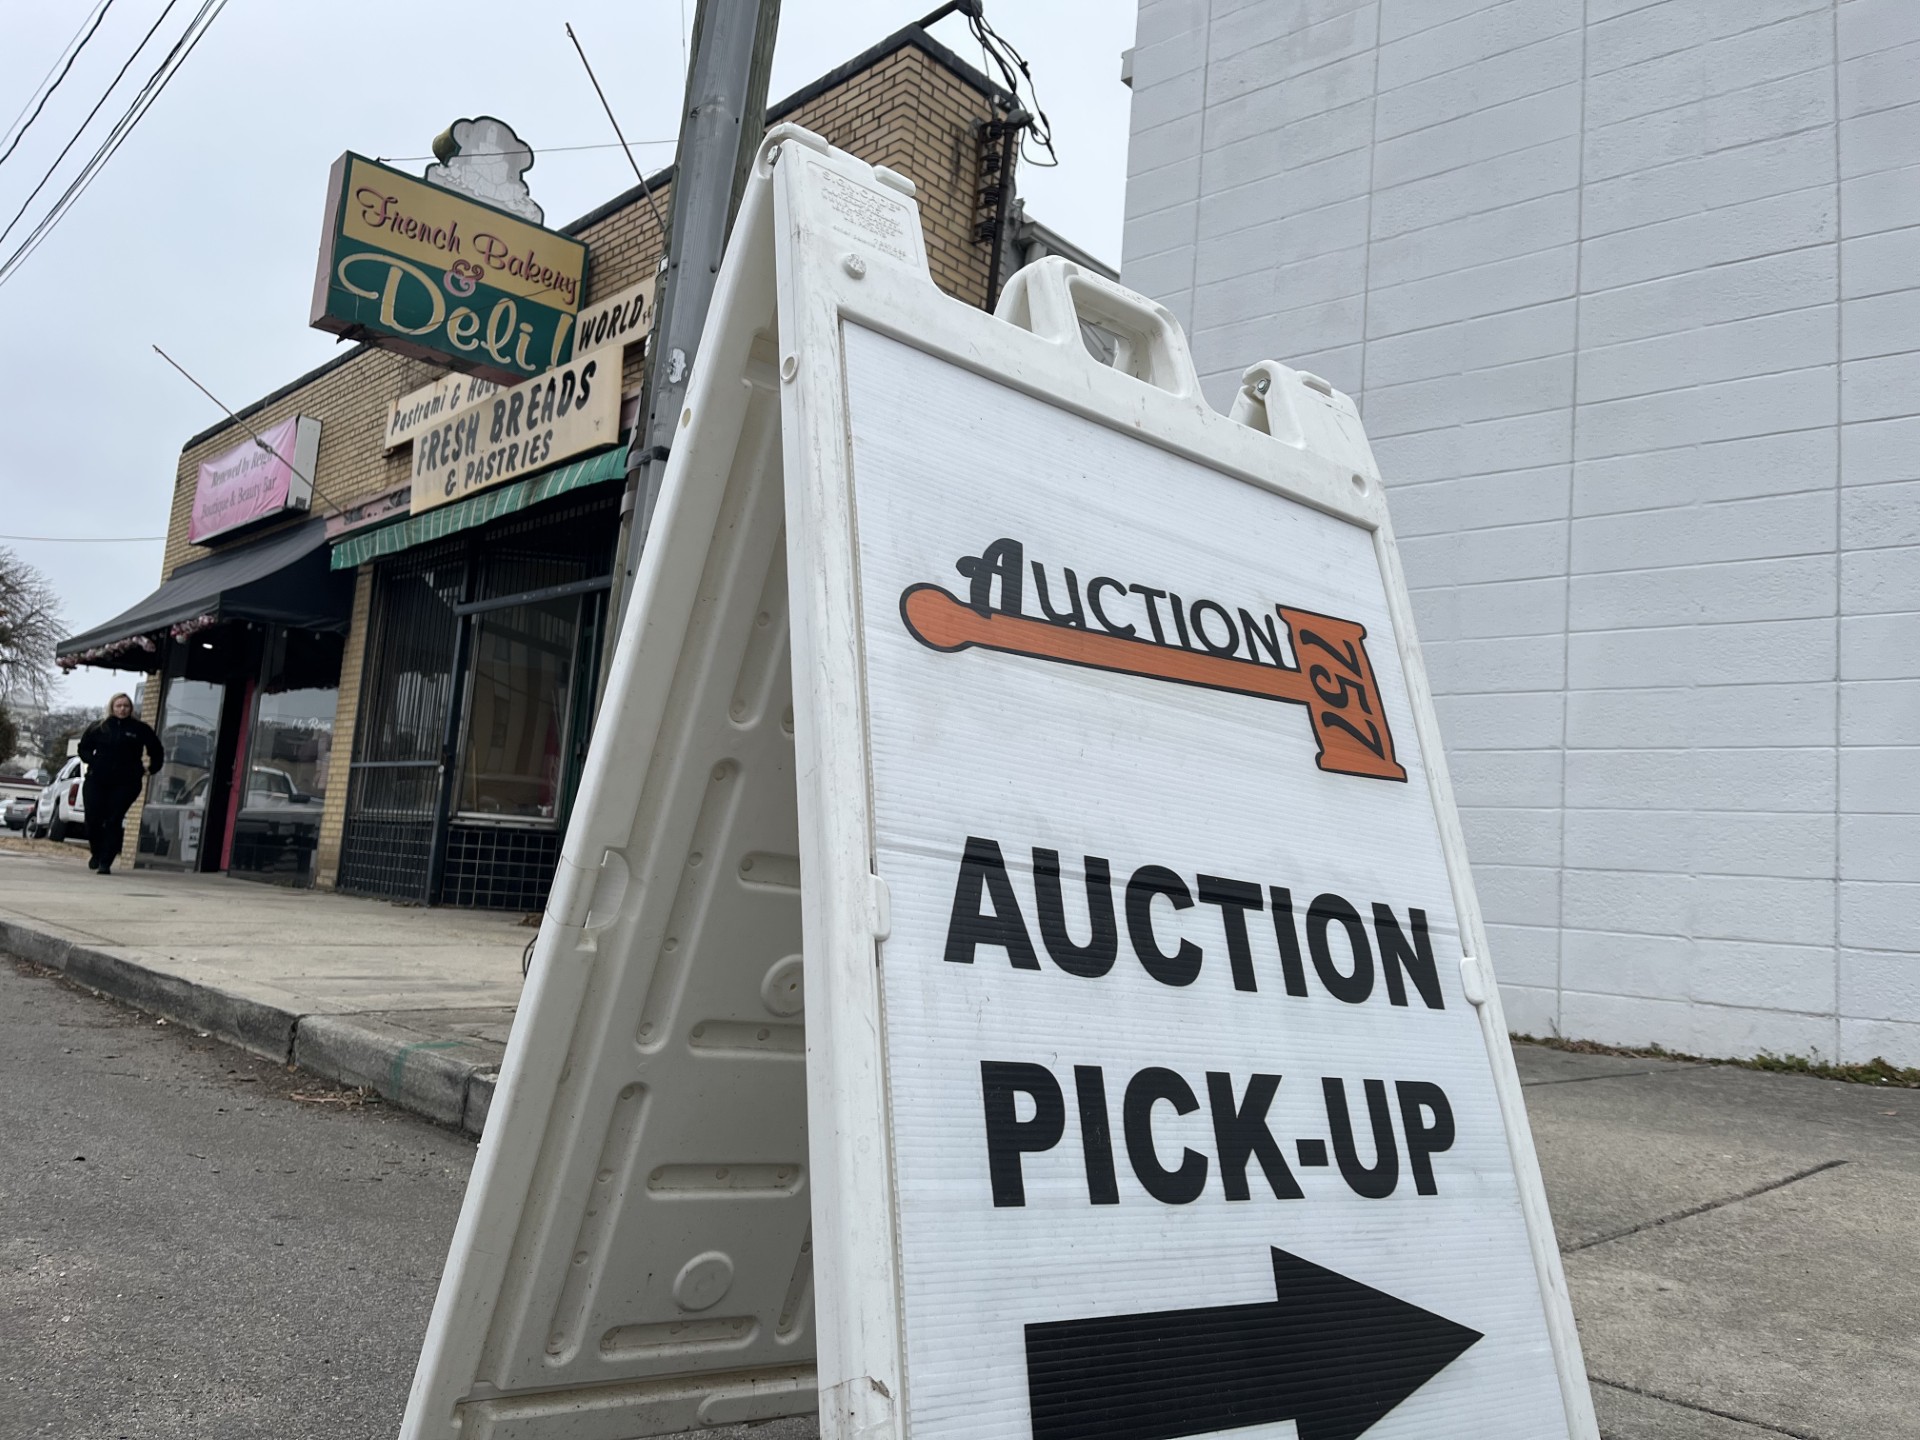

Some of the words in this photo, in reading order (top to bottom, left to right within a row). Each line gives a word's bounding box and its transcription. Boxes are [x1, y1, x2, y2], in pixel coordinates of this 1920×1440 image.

[355, 186, 461, 254] French
[473, 233, 577, 305] Bakery
[443, 259, 485, 297] &
[579, 293, 644, 352] WORLD
[391, 385, 448, 436] Pastrami
[450, 382, 461, 410] &
[417, 410, 480, 476] FRESH
[490, 360, 597, 444] BREADS
[444, 467, 457, 497] &
[464, 429, 553, 488] PASTRIES
[1299, 627, 1386, 761] 757
[943, 835, 1445, 1010] AUCTION
[980, 1060, 1455, 1208] PICK-UP
